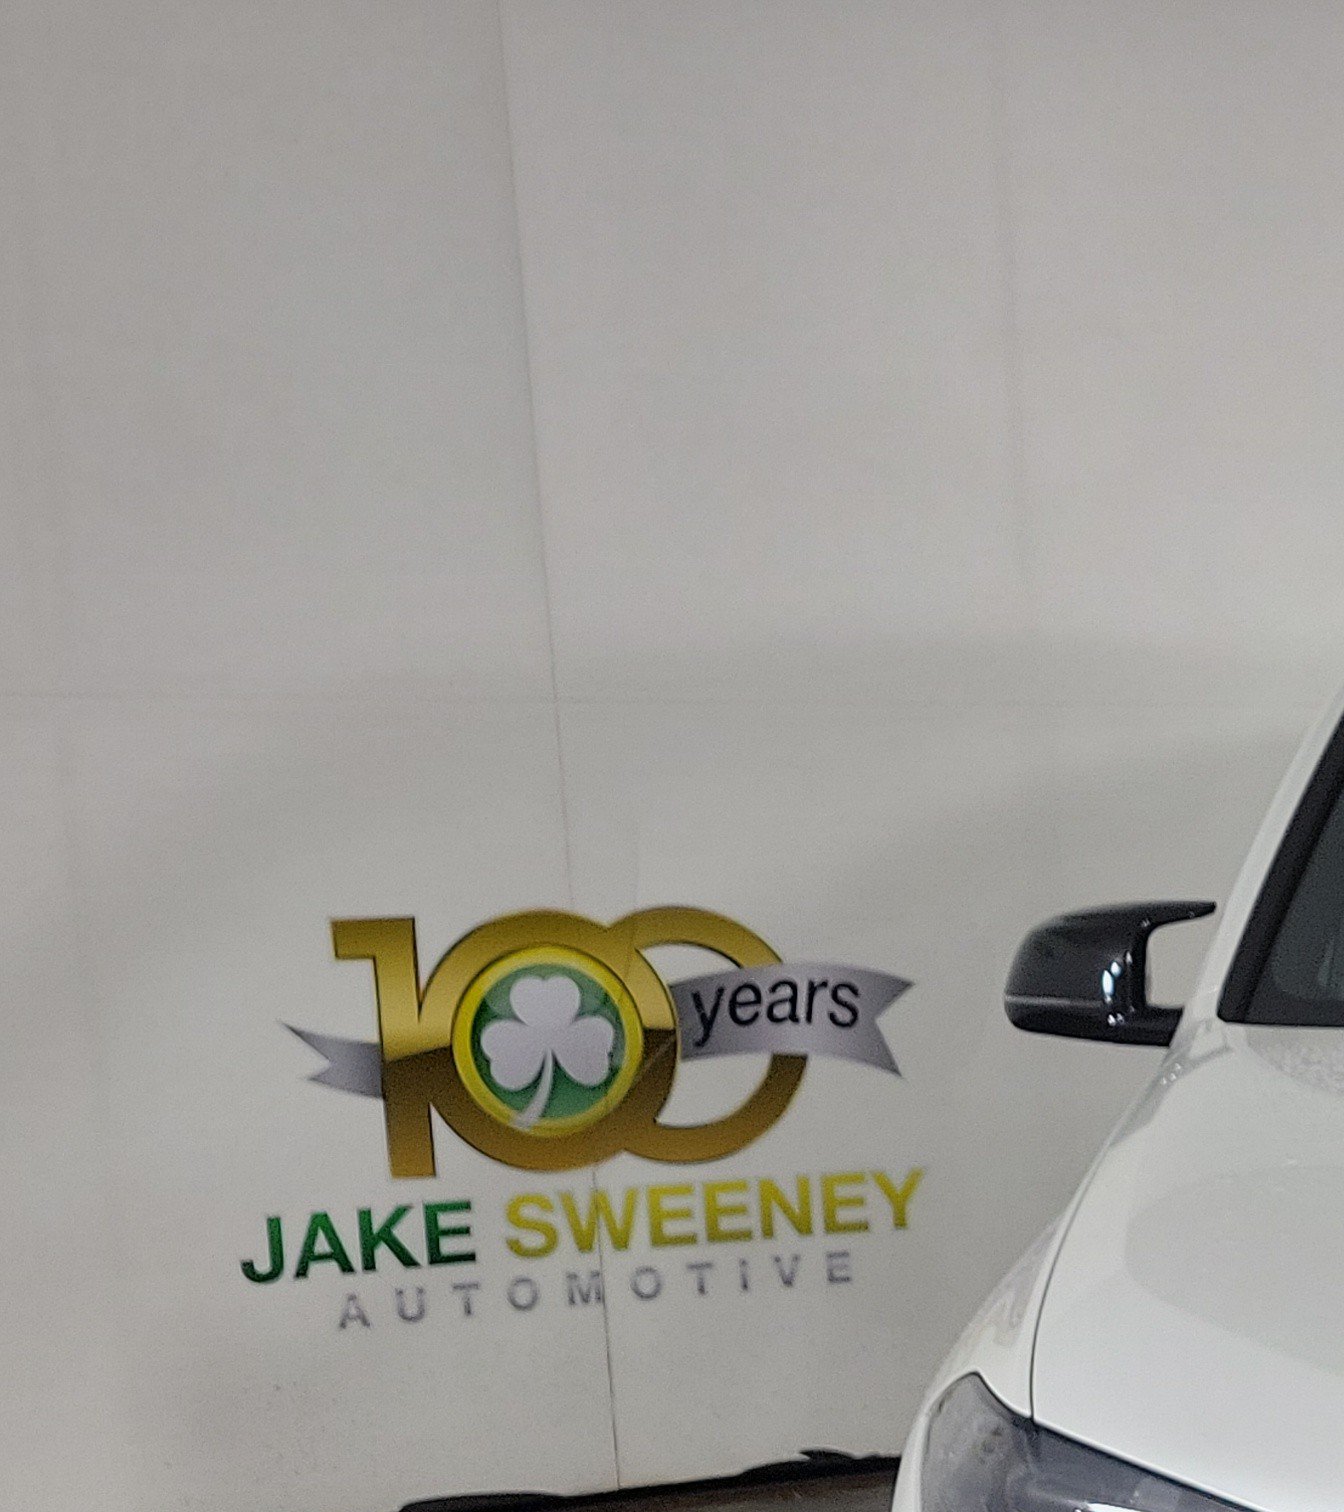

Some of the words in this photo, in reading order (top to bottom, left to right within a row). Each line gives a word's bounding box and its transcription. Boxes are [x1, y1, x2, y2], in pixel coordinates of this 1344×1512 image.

[330, 905, 810, 1179] 100
[691, 975, 861, 1047] years
[240, 1200, 478, 1284] JAKE
[504, 1167, 926, 1260] SWEENEY
[337, 1250, 854, 1330] AUTOMOTIVE
